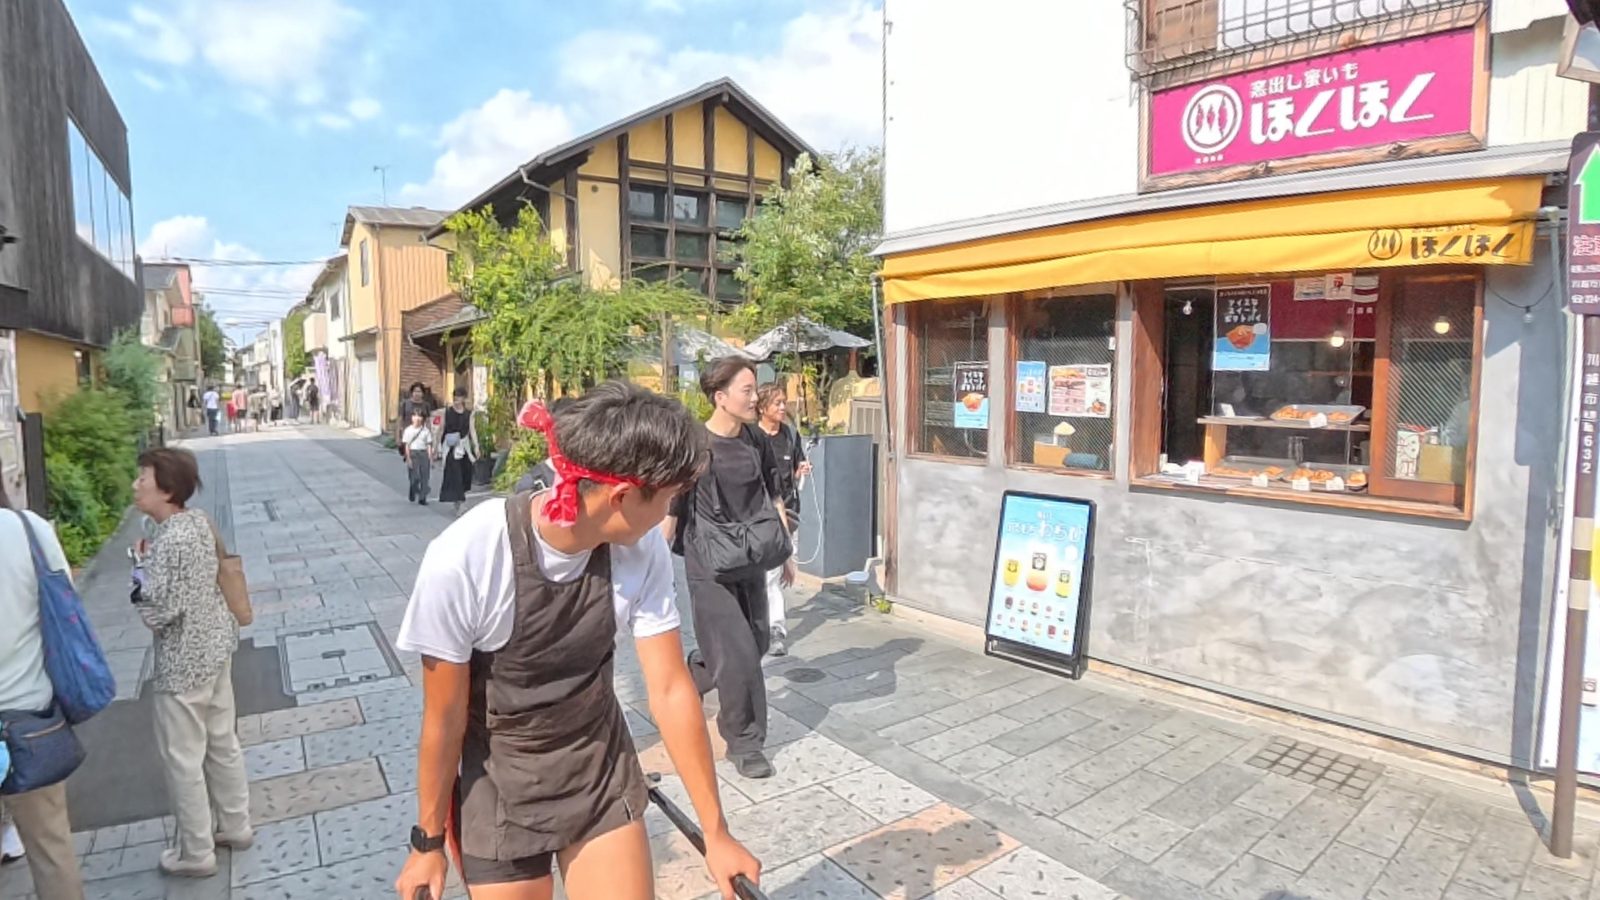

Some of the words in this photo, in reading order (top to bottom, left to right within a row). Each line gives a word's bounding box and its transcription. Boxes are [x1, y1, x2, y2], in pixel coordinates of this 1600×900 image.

[1250, 72, 1436, 145] ほくほく
[1410, 232, 1515, 260] ほくほく
